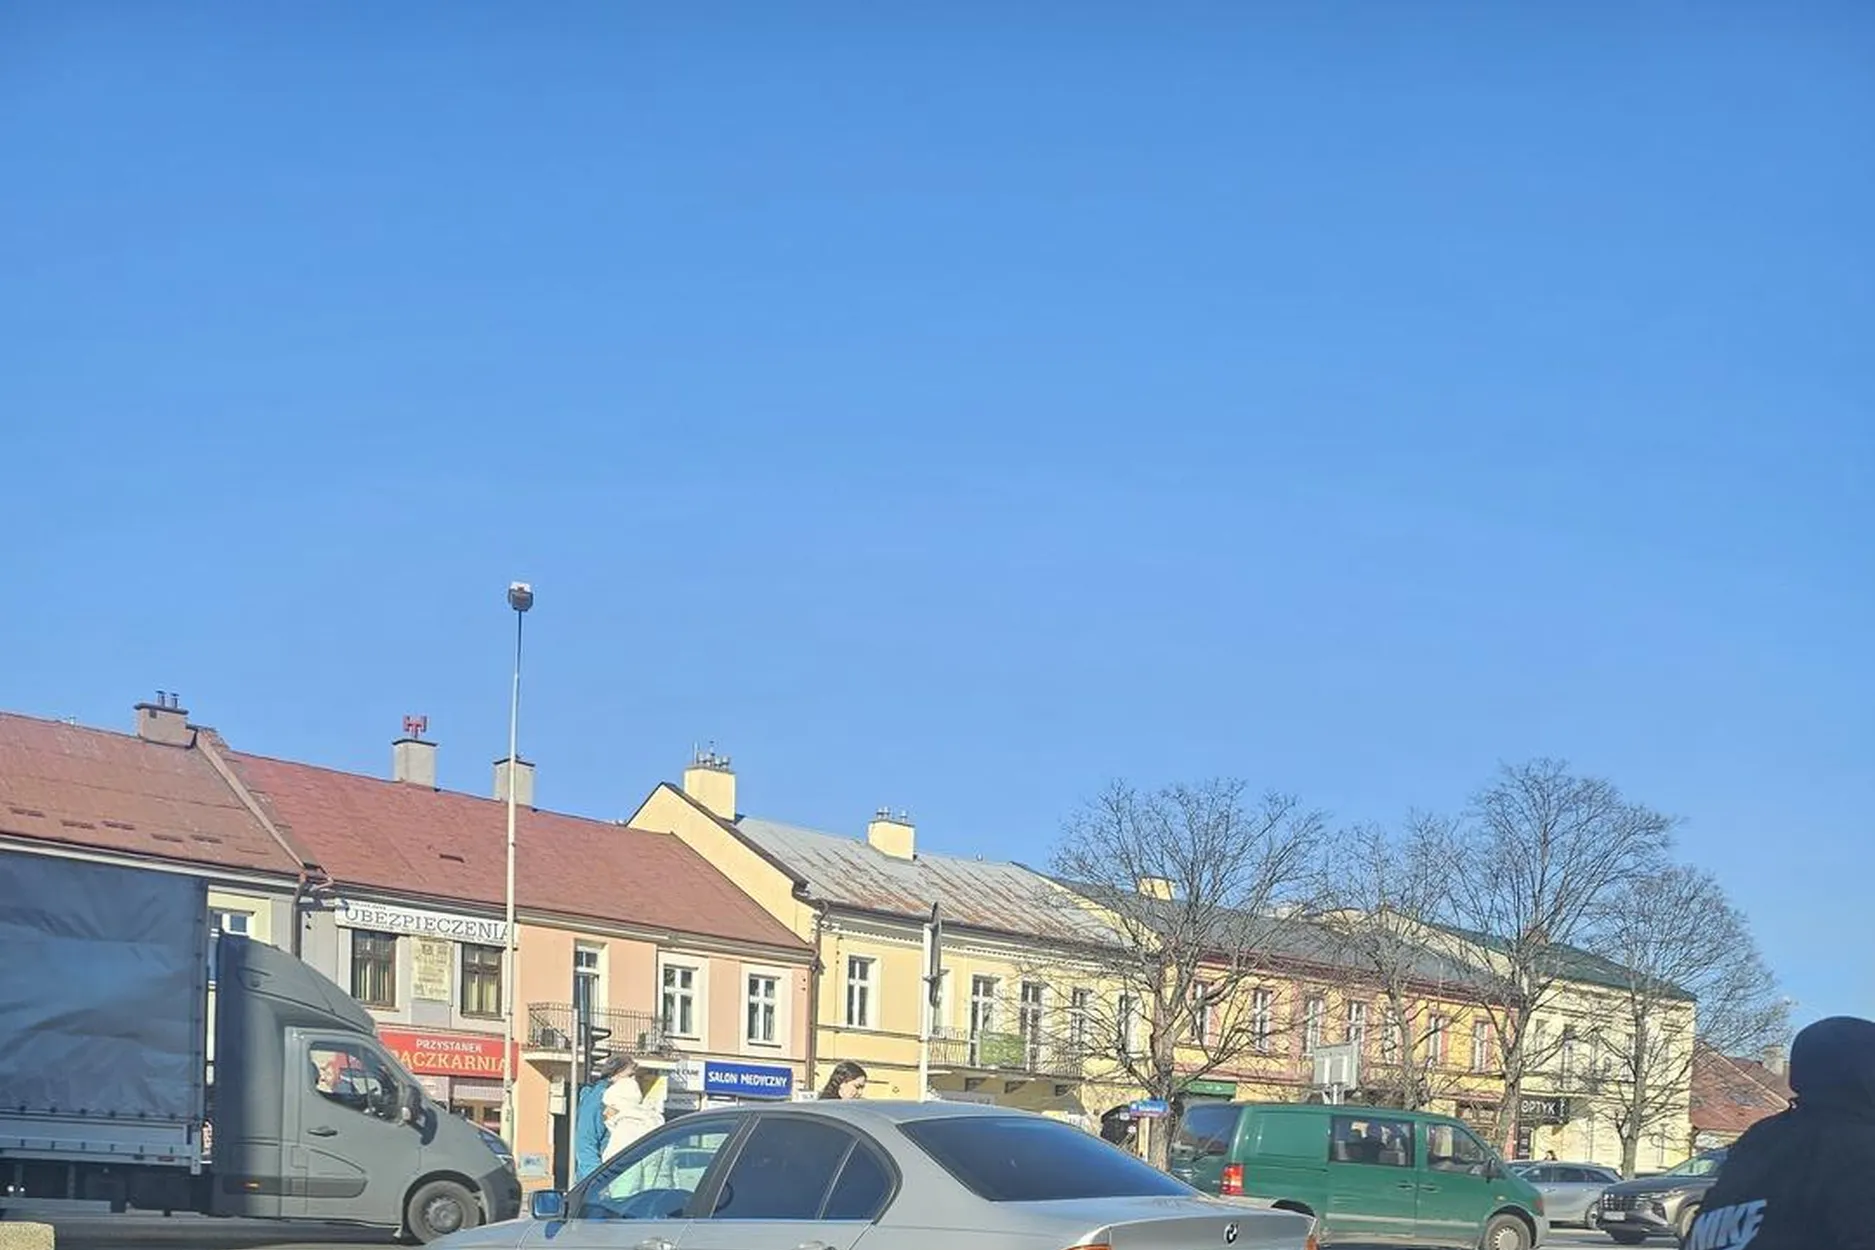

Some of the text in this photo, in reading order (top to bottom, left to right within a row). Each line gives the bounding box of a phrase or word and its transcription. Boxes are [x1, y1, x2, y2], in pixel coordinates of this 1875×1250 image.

[345, 908, 508, 940] UBEZPIECZENIA
[416, 1039, 482, 1053] PRZYSTANEK
[708, 1071, 788, 1088] SALON MEDYCZNY
[1521, 1100, 1556, 1115] OPTYK
